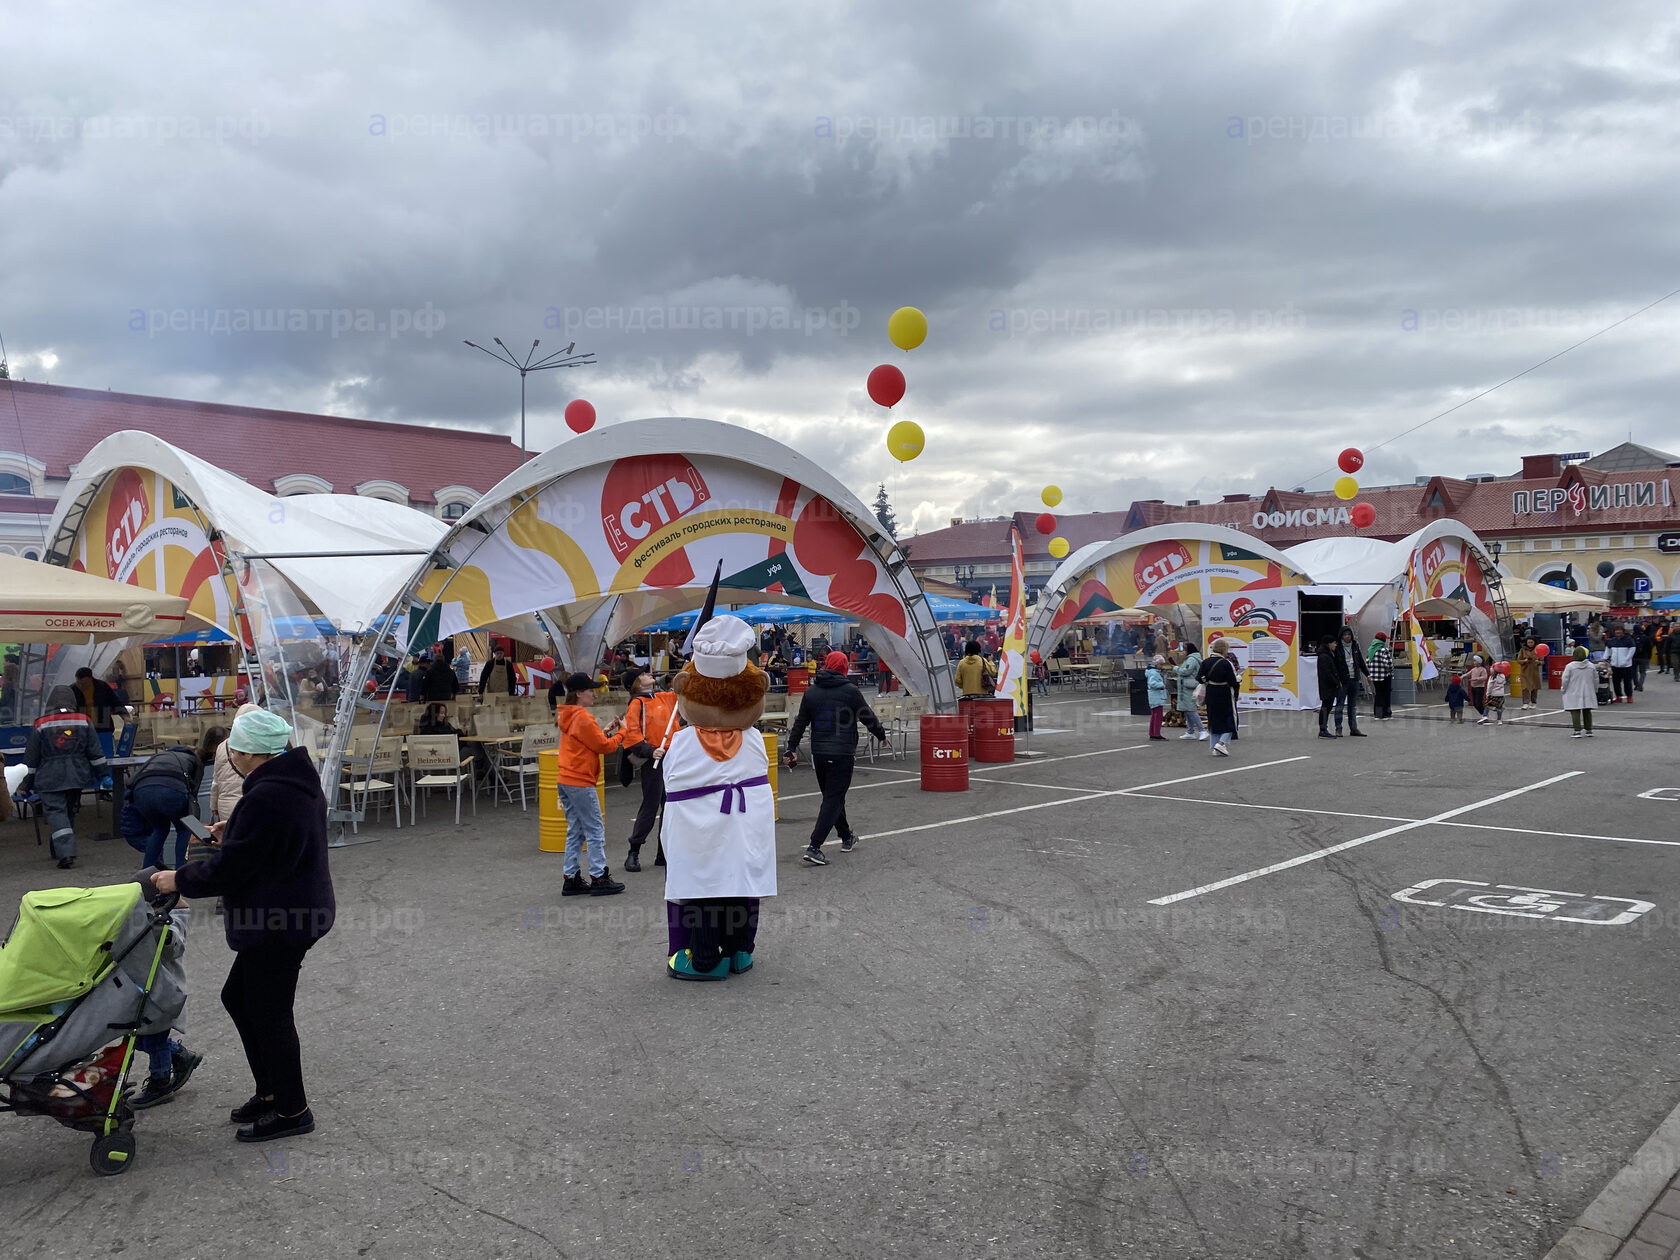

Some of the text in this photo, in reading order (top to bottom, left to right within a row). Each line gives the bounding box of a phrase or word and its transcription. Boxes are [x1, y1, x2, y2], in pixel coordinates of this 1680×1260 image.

[1513, 481, 1656, 516] ПЕРЧИНИ
[1252, 506, 1352, 530] ОФИСМА
[159, 526, 188, 538] ресторанов
[634, 516, 787, 568] фестиваль городских ресторанов
[766, 562, 783, 577] уфа
[1147, 566, 1240, 597] фестиваль городских ресторанов
[1638, 581, 1648, 591] P
[45, 618, 116, 628] ОСВЕЖАЙСЯ
[532, 738, 556, 746] AMSTEL
